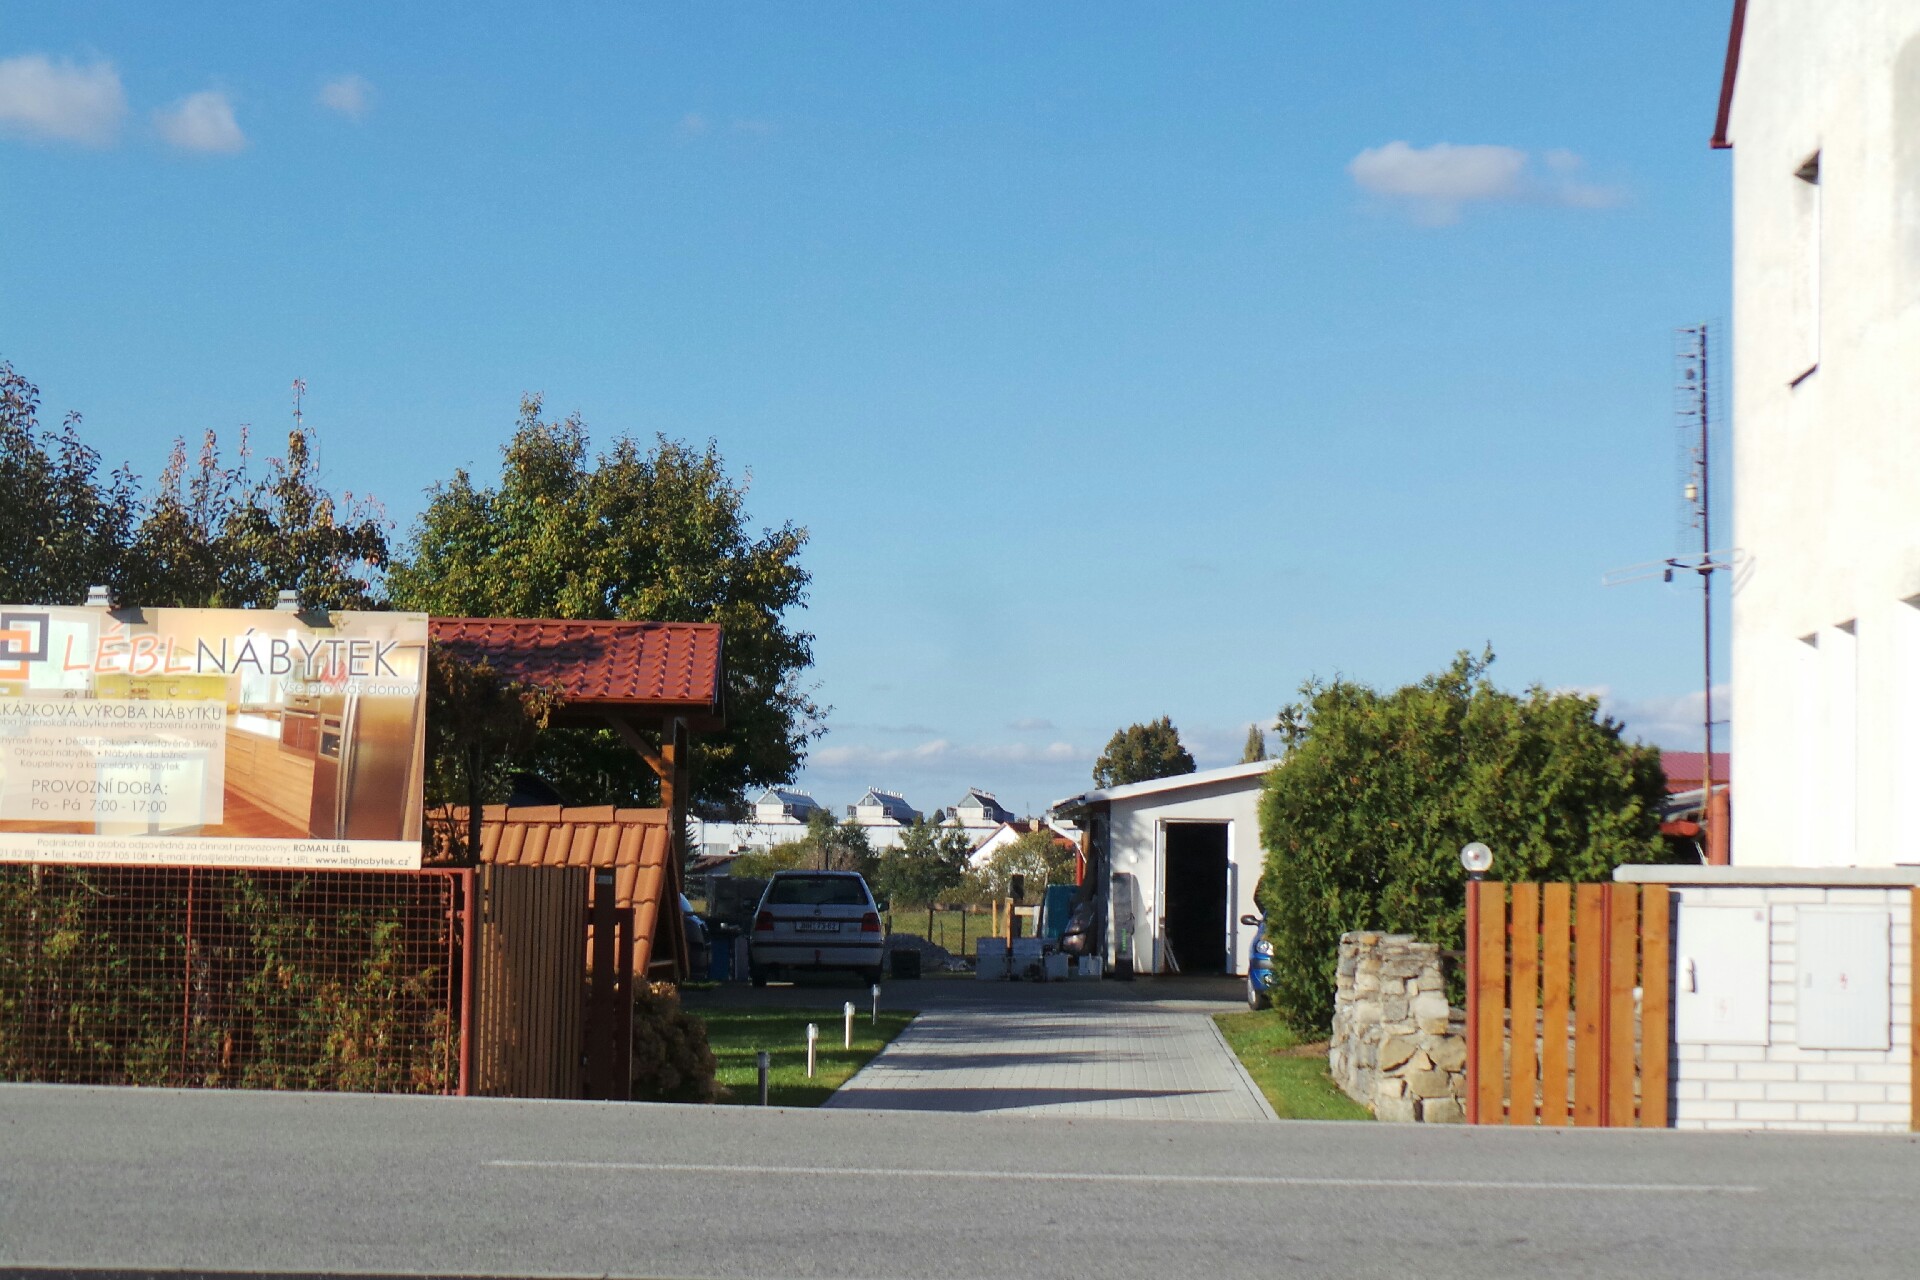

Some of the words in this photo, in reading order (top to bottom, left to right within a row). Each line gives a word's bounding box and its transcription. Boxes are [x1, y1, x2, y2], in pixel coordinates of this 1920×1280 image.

[196, 627, 398, 677] NÁBYTEK
[309, 684, 333, 696] pro
[367, 682, 420, 696] domov
[0, 699, 77, 718] KÁZKOVÁ
[83, 702, 148, 719] VÝROBA
[153, 703, 222, 721] NÁBYTKU
[110, 720, 136, 729] nebo
[139, 720, 183, 731] vybavení
[185, 722, 198, 730] na
[31, 777, 114, 794] PROVOZNÍ
[117, 780, 168, 796] DOBA:
[31, 798, 49, 811] Po
[62, 798, 81, 811] Pá
[89, 799, 118, 812] 7:00
[133, 799, 167, 813] 17:00
[37, 838, 86, 848] Podnikatel
[97, 840, 126, 849] osoba
[128, 841, 183, 852] odpovědná
[199, 842, 233, 851] činnost
[293, 843, 329, 853] ROMAN
[331, 842, 351, 853] LÉBL
[315, 856, 409, 867] www.leblnabytek.cz
